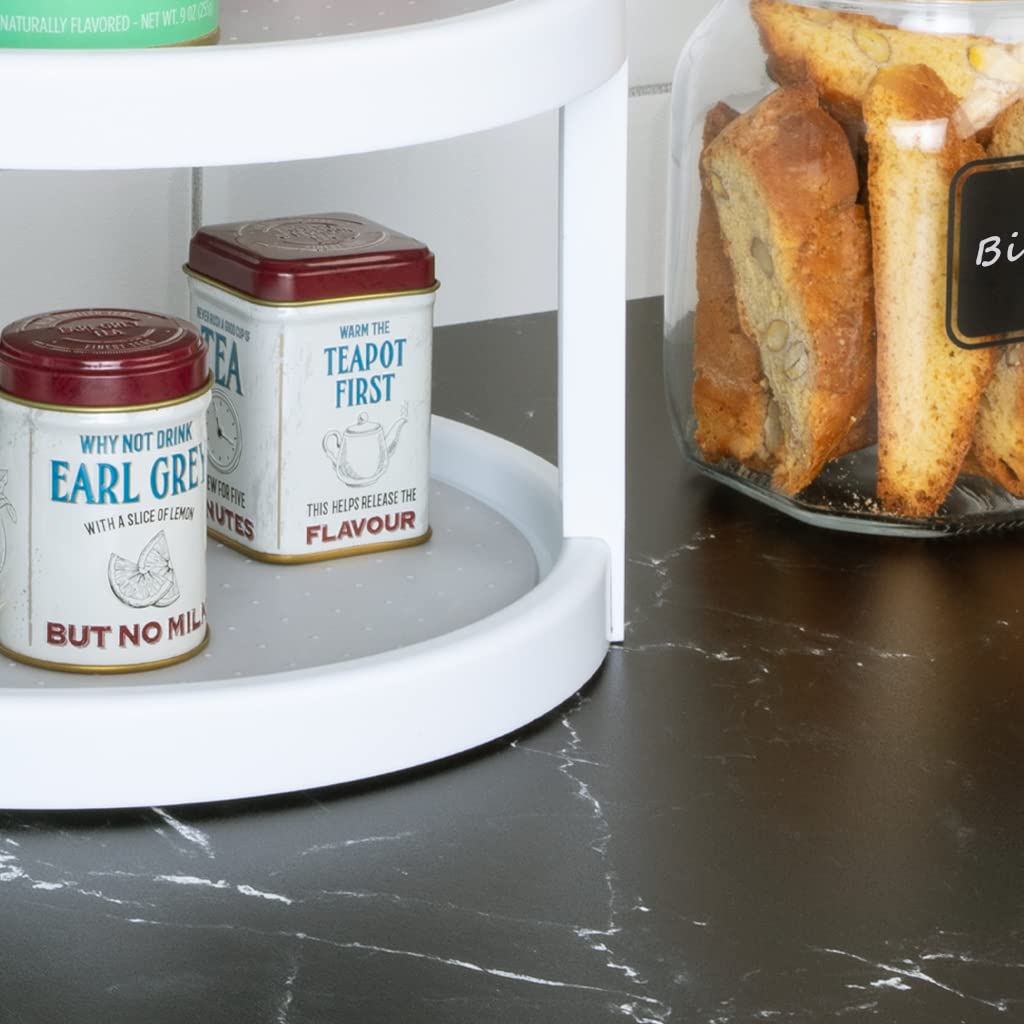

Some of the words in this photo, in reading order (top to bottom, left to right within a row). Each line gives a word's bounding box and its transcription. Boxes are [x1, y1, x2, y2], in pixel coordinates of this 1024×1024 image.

[0, 14, 67, 33] NATURALLY
[70, 14, 130, 33] FLAVORED
[140, 11, 160, 29] NET
[180, 7, 186, 24] 9
[339, 323, 369, 339] WARM
[371, 320, 390, 335] THE
[201, 325, 244, 396] TEA
[324, 338, 407, 376] TEAPOT
[336, 373, 396, 408] FIRST
[80, 435, 119, 454] WHY
[122, 432, 153, 453] NOT
[157, 421, 192, 449] DRINK
[51, 460, 140, 504] EARL
[218, 480, 230, 501] FOR
[230, 487, 246, 509] FIVE
[307, 502, 328, 517] THIS
[332, 496, 360, 514] HELPS
[361, 491, 399, 510] RELEASE
[401, 487, 416, 503] THE
[84, 517, 115, 535] WITH
[118, 515, 125, 528] A
[127, 509, 155, 526] SLICE
[158, 507, 169, 521] OF
[170, 506, 195, 520] LEMON
[207, 499, 254, 541] NUTES
[306, 511, 416, 545] FLAVOUR
[47, 622, 112, 648] BUT
[119, 621, 162, 645] NO
